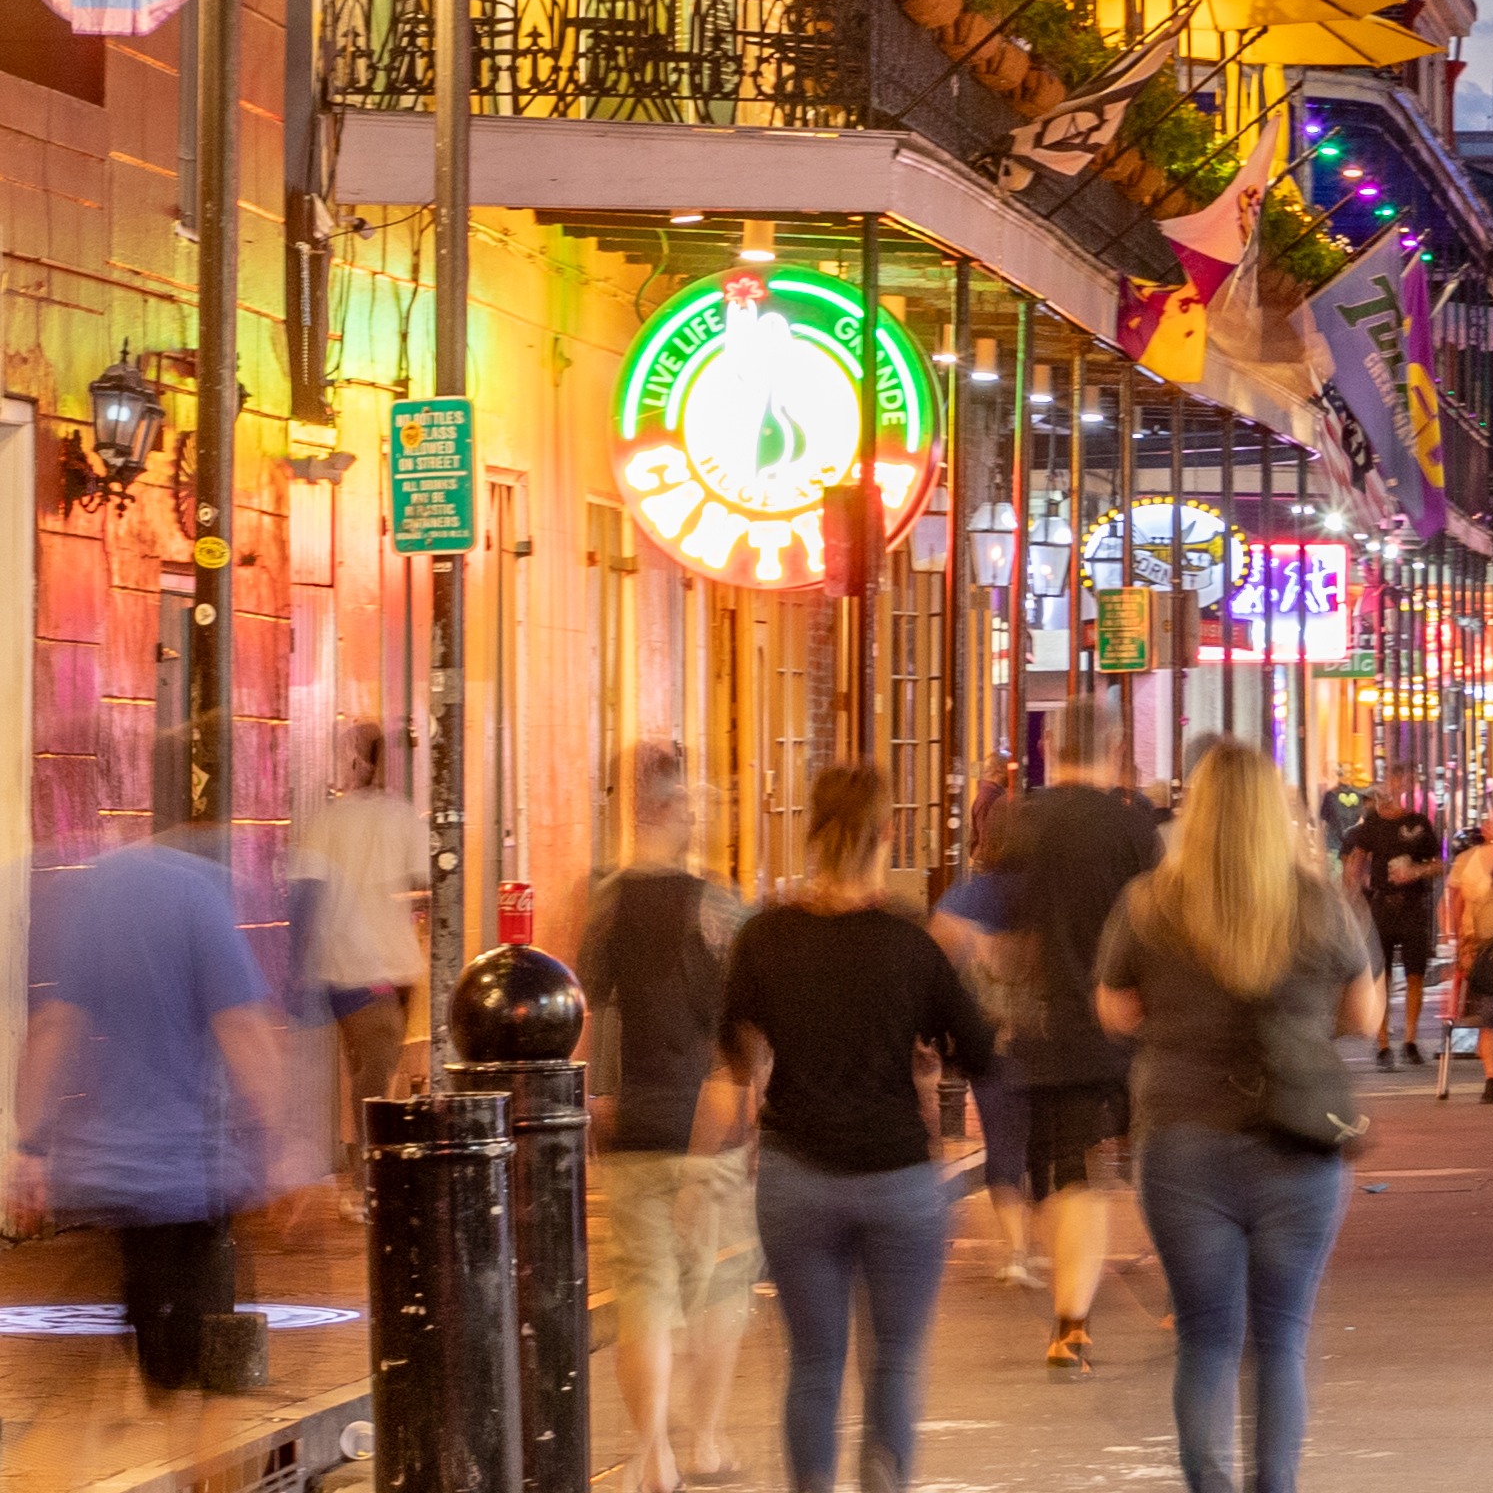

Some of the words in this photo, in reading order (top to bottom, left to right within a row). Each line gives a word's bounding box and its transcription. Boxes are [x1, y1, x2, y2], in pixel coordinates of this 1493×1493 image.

[642, 350, 684, 409] LIVE
[671, 306, 726, 355] LIFE
[415, 455, 462, 471] STREET
[421, 426, 458, 441] LASS
[624, 444, 917, 581] CANTIA
